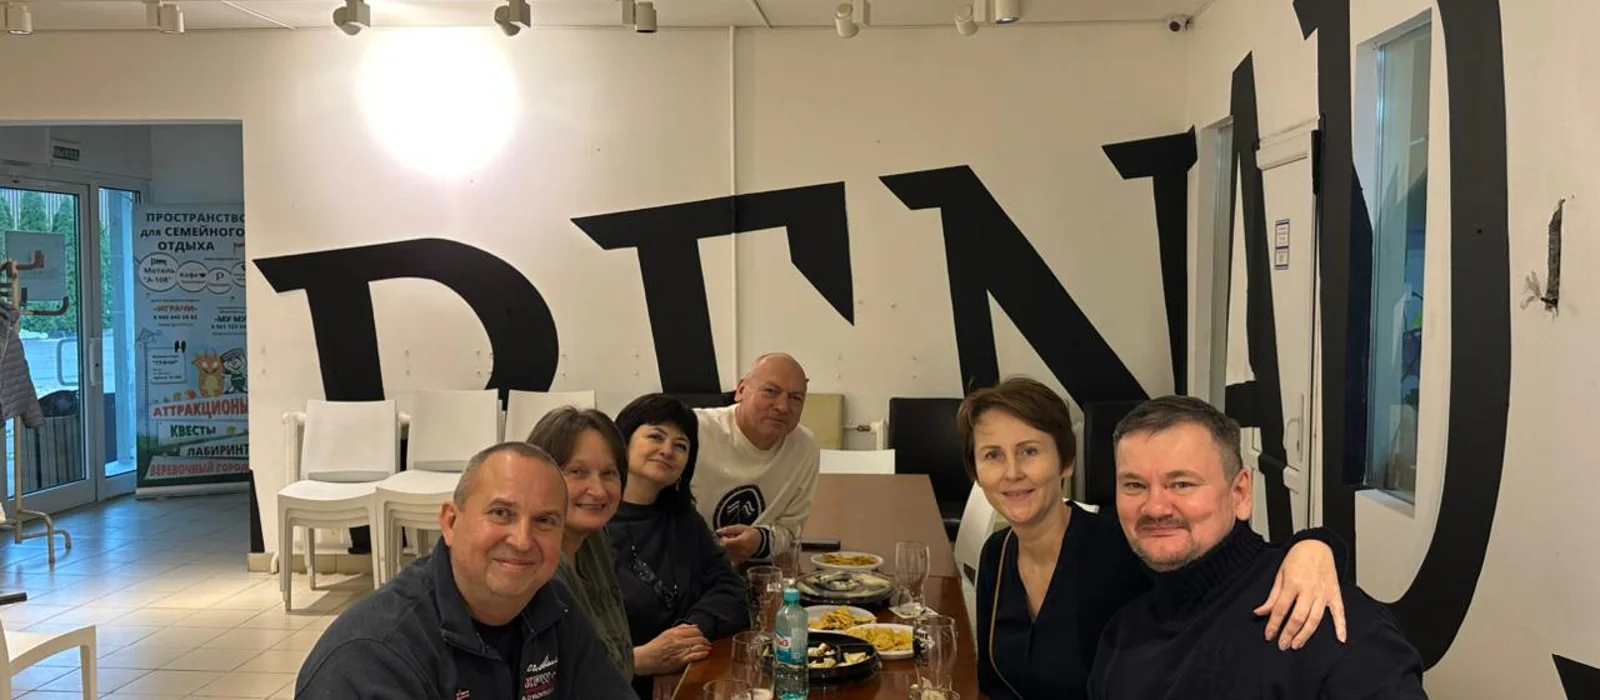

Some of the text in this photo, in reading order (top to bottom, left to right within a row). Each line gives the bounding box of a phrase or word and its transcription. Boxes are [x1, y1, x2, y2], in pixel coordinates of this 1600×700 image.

[140, 224, 245, 238] для СЕМЕЙНОГО
[158, 241, 215, 253] ОТДЫХА
[170, 425, 217, 438] КВЕСТЫ
[187, 444, 249, 456] ЛАБИРИНТ
